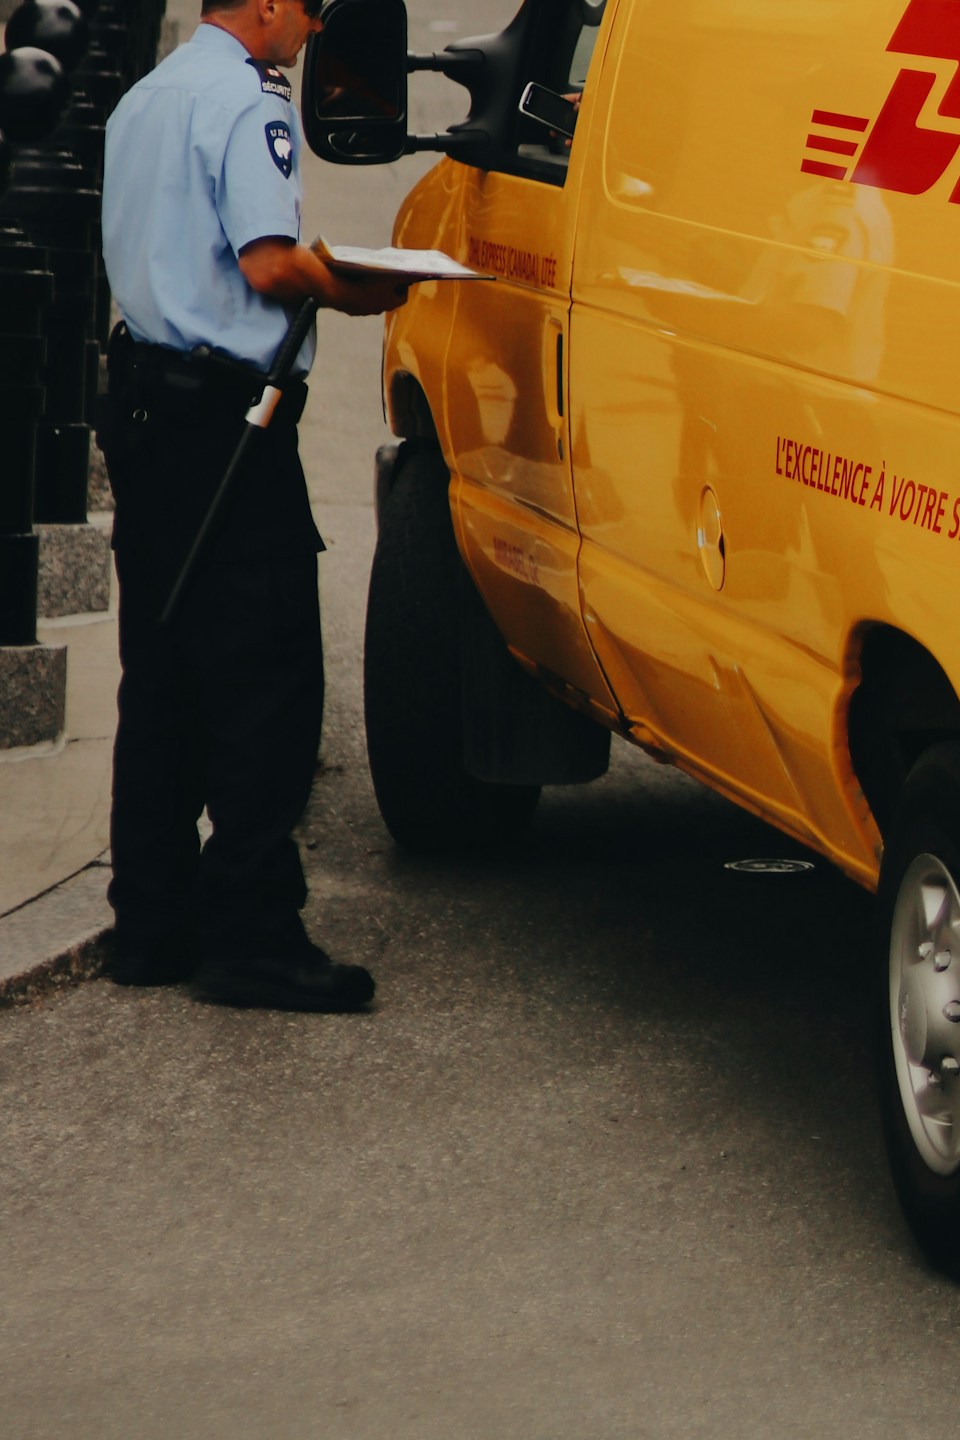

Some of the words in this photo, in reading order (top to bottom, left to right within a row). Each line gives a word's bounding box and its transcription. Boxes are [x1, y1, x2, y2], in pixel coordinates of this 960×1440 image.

[261, 80, 291, 99] SÉCURITÉ
[774, 436, 873, 508] L'EXCELLENCE
[869, 460, 886, 512] À
[889, 475, 949, 534] VOTRE
